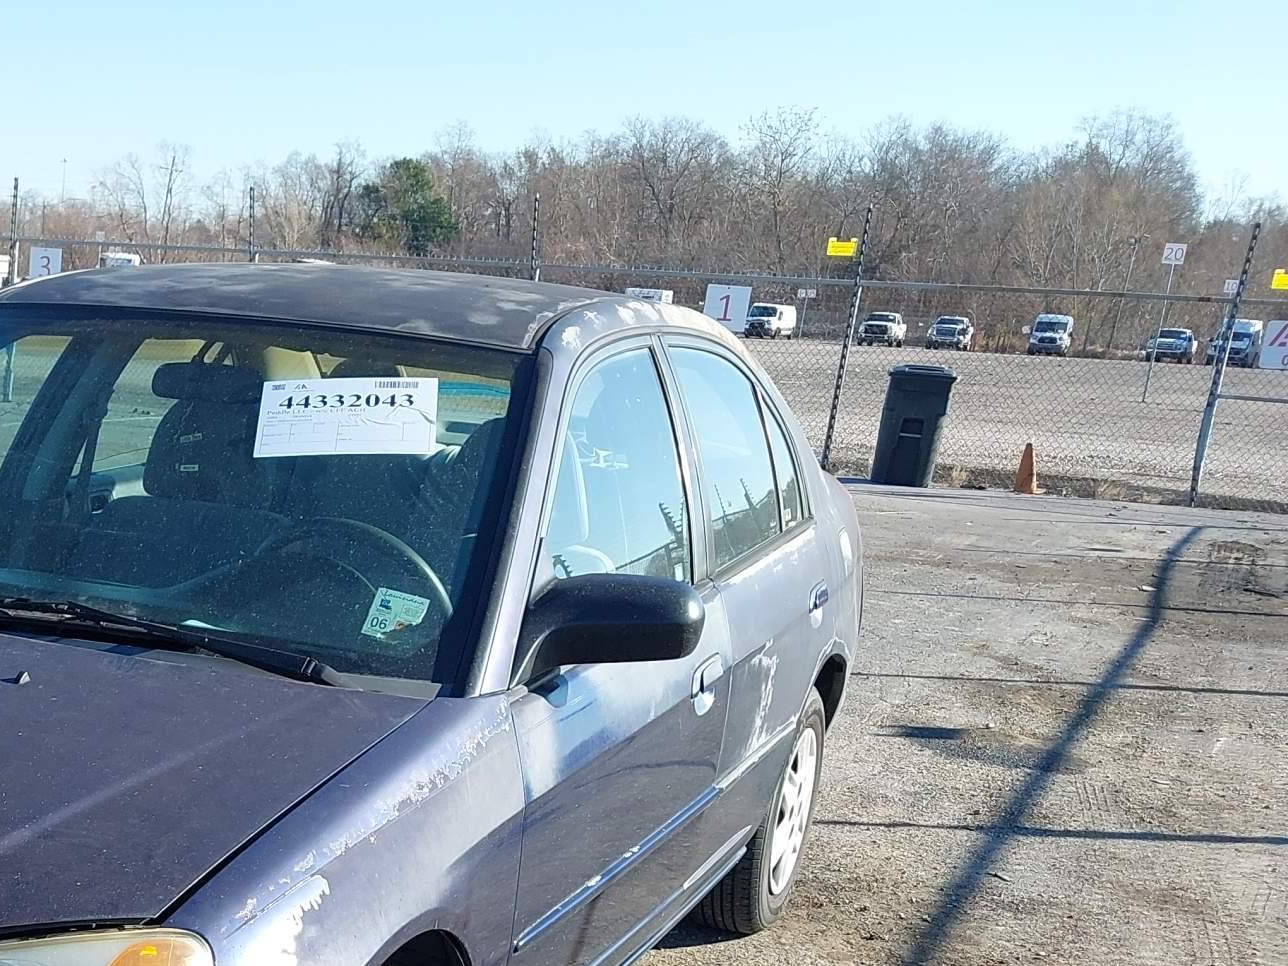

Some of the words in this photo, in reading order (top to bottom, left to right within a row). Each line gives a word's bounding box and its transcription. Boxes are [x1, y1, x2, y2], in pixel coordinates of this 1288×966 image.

[1164, 247, 1184, 261] 20
[39, 256, 51, 276] 3
[716, 294, 732, 322] 1
[279, 393, 415, 410] 44332043
[370, 616, 388, 630] 06
